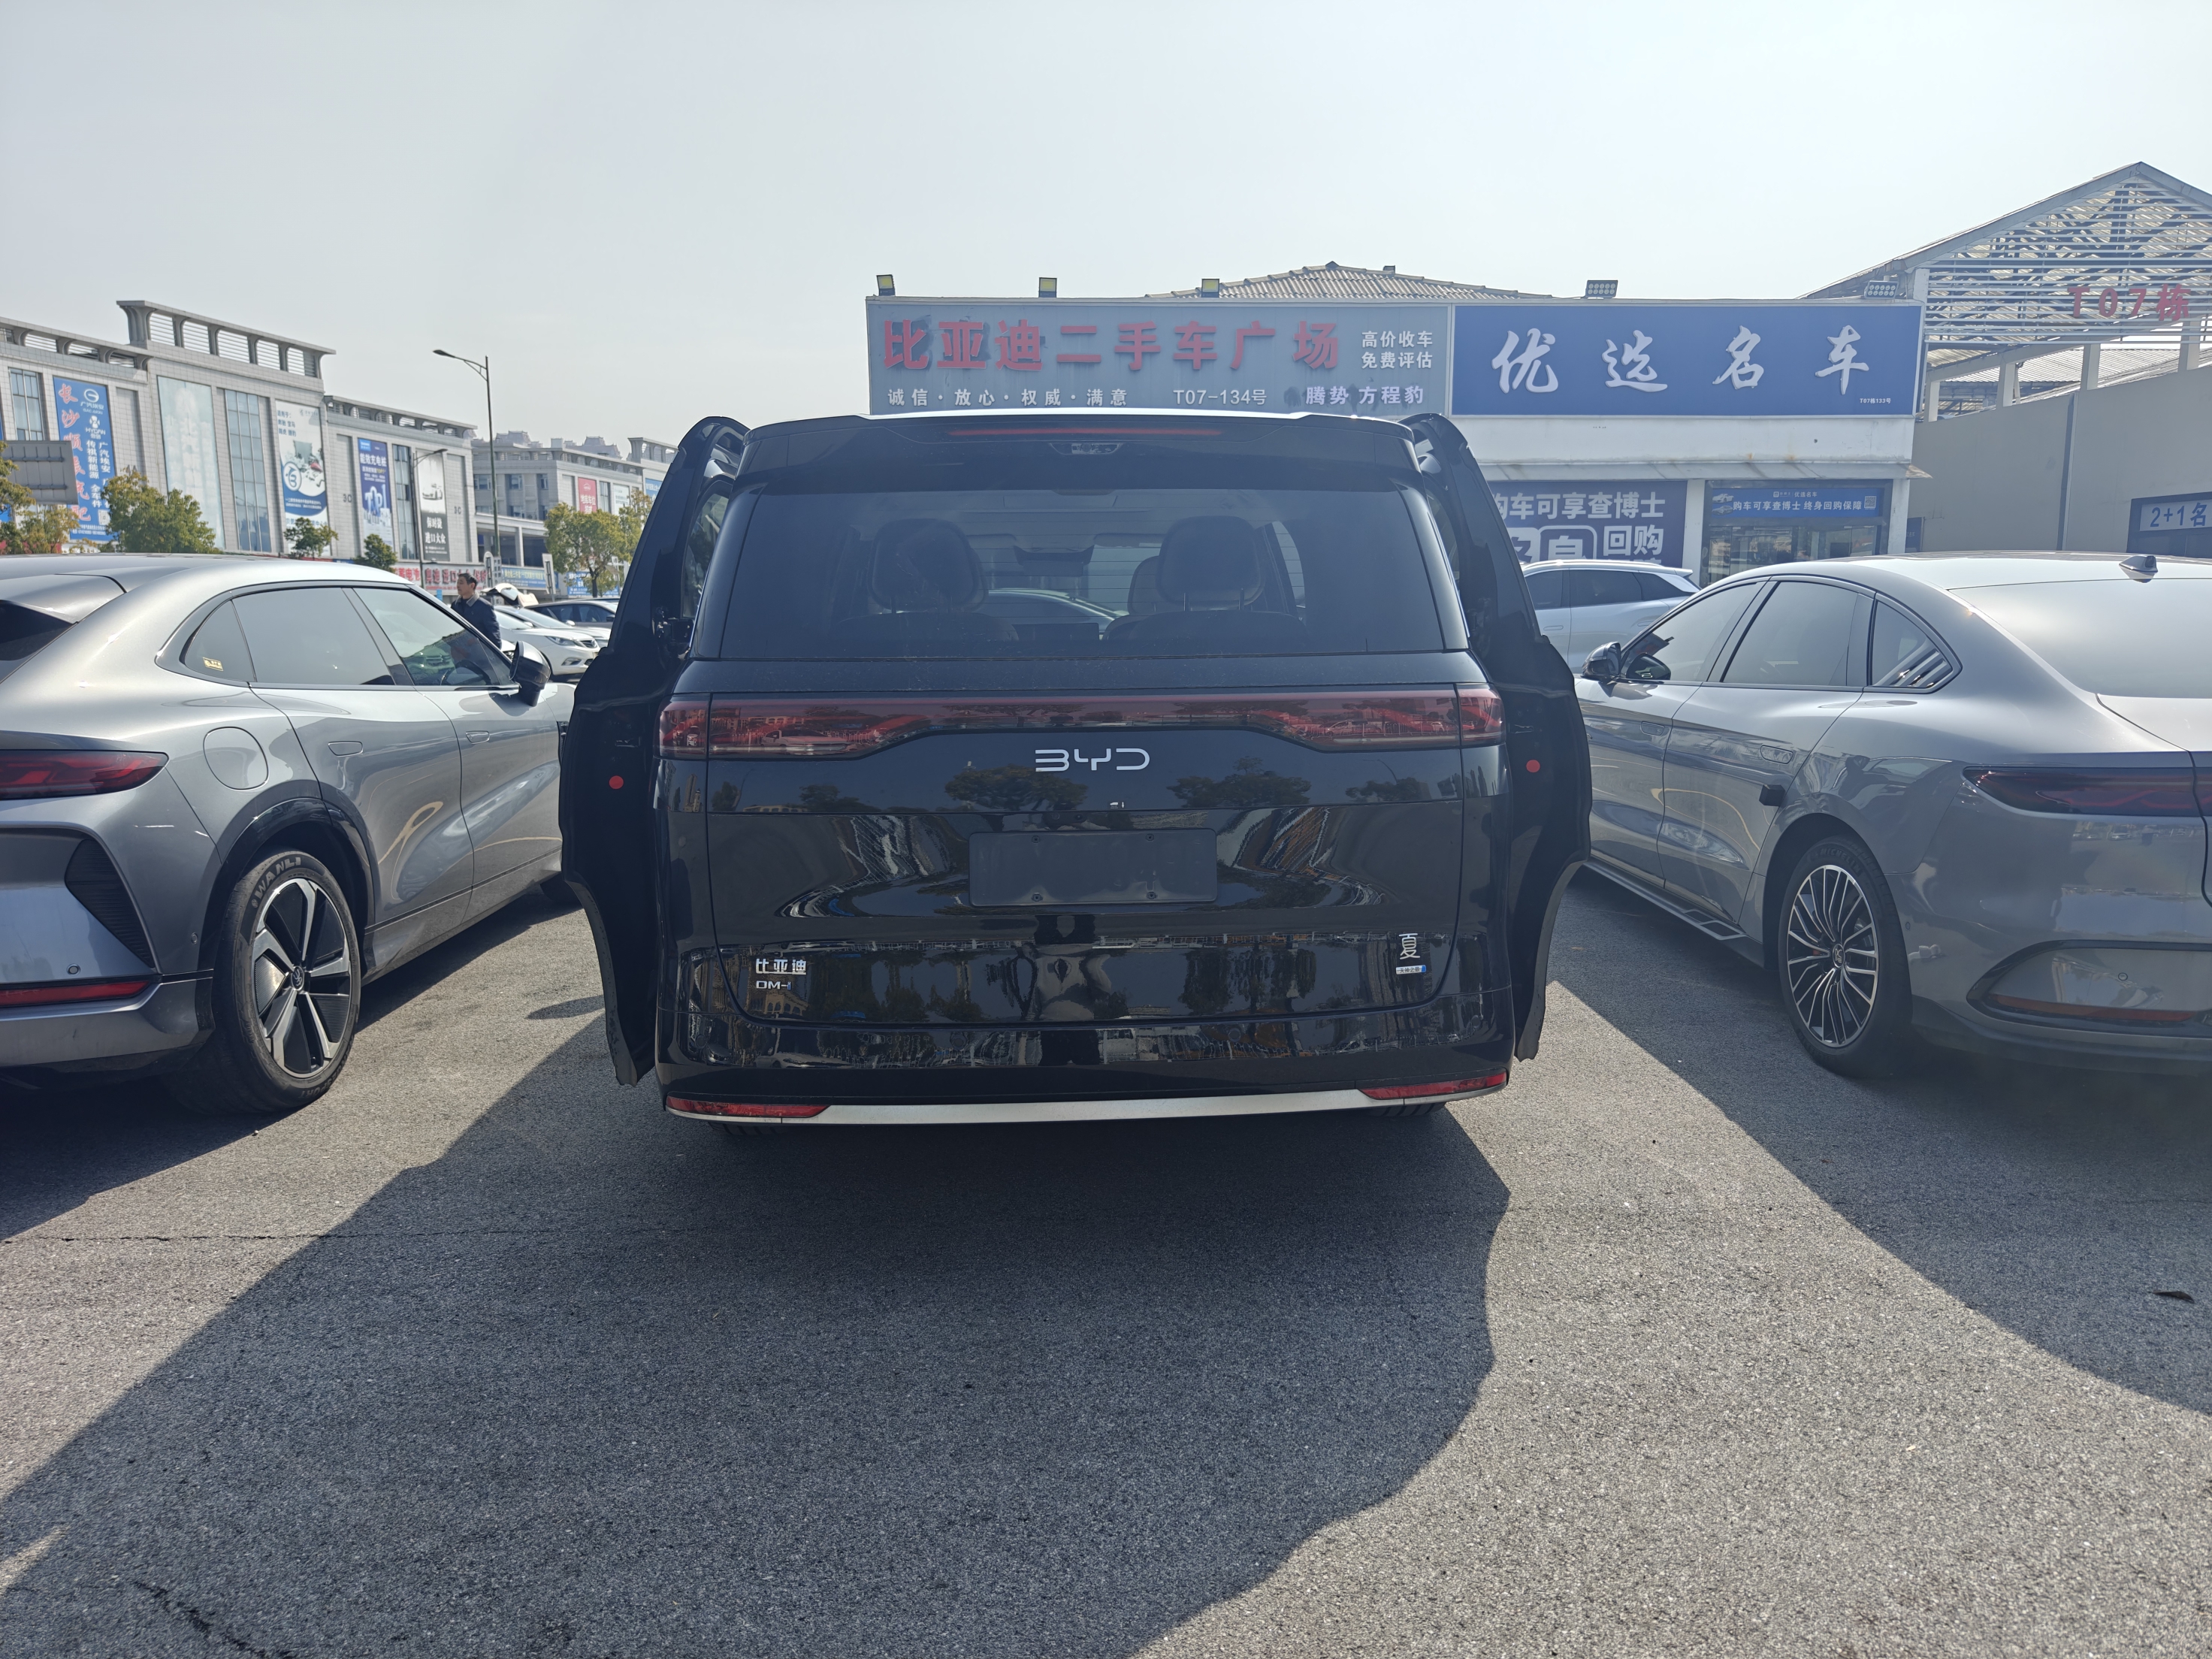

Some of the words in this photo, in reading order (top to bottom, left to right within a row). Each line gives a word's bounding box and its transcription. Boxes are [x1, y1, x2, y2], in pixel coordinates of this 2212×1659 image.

[2068, 284, 2191, 321] T07栋
[884, 319, 1339, 371] 比亚迪二手车广场
[1361, 331, 1434, 348] 高价收车
[1361, 351, 1433, 369] 免费评估
[1491, 324, 1869, 395] 优选名车
[1174, 389, 1267, 405] T07-134号
[1306, 386, 1349, 405] 腾势
[1358, 386, 1424, 404] 方程豹
[1733, 500, 1800, 511] 购车可享查博士
[1803, 500, 1863, 511] 终身回购保障
[425, 532, 446, 544] 进口大众
[1603, 524, 1664, 557] 回购
[1035, 748, 1150, 772] BYD
[255, 857, 301, 899] WANLI
[1398, 933, 1421, 959] 夏
[756, 958, 806, 975] 比亚迪
[756, 981, 791, 990] DM-i
